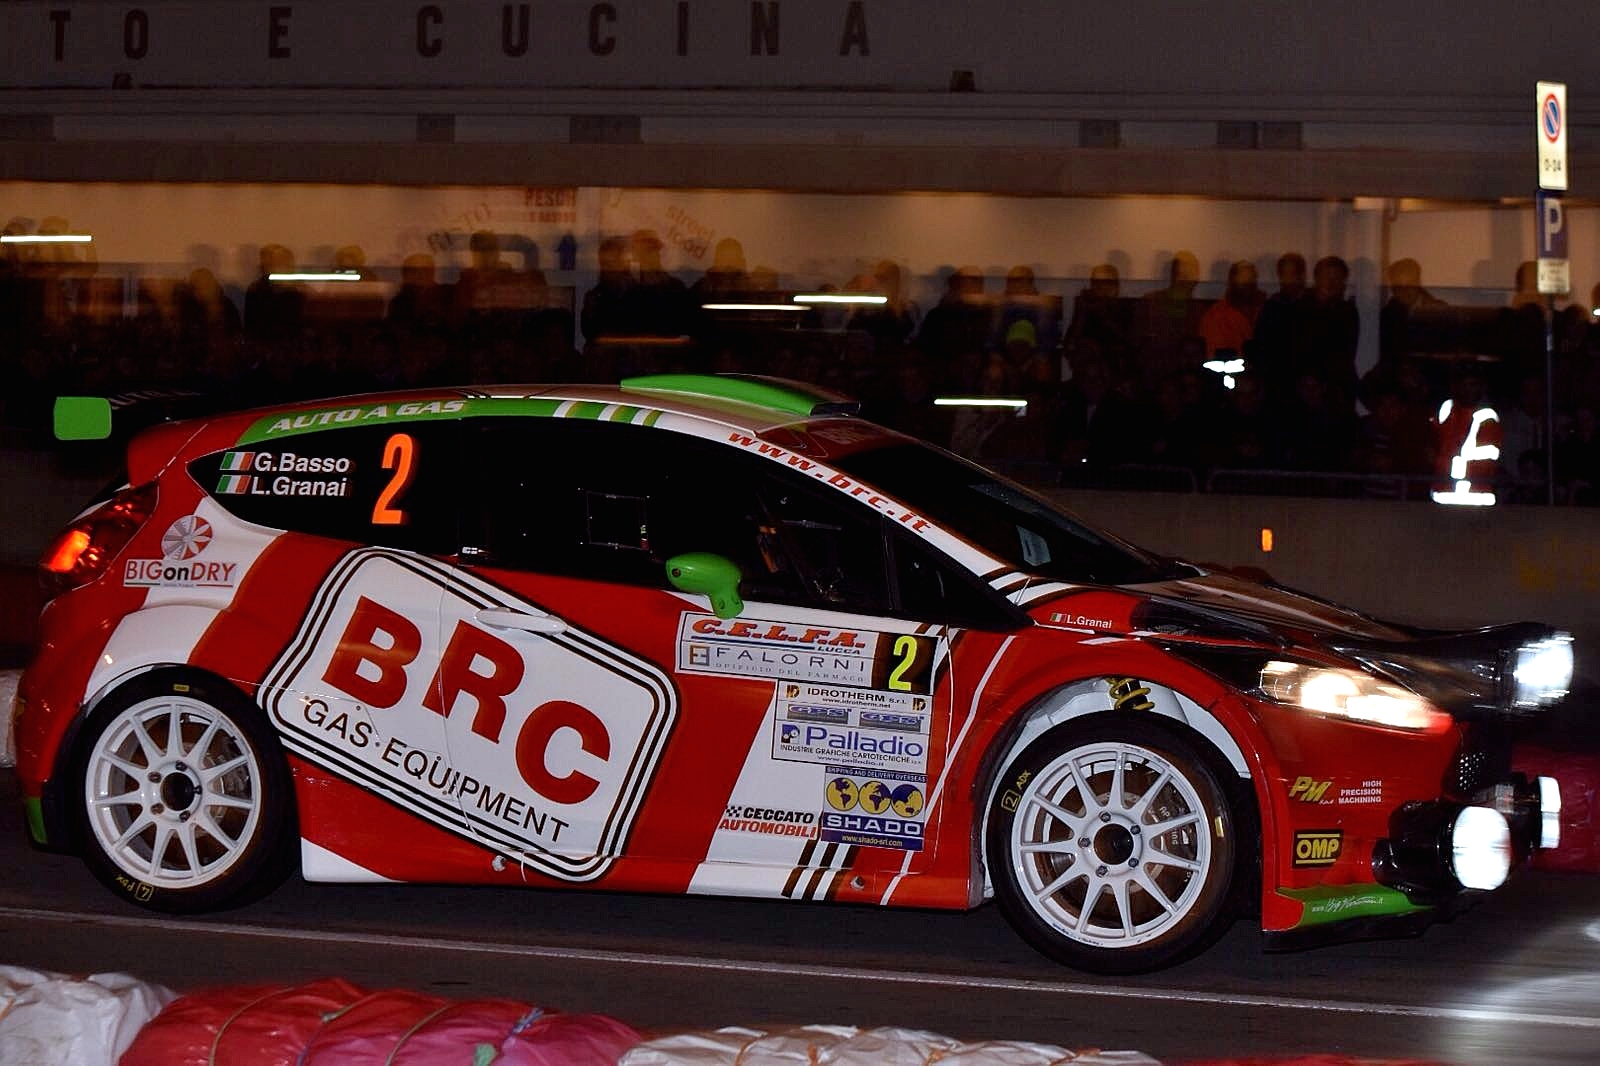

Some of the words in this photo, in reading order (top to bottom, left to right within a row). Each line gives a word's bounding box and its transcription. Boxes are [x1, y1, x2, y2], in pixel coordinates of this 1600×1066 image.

[416, 1, 870, 58] CUCINA
[1543, 197, 1563, 252] P
[265, 408, 361, 434] AUTO
[362, 405, 388, 420] A
[395, 400, 467, 416] GAS
[253, 452, 350, 473] G.Basso
[250, 476, 348, 497] L.Granai
[371, 433, 414, 525] 2
[728, 432, 931, 534] www.brc.it
[124, 560, 237, 581] BIGonDRY
[1066, 614, 1113, 629] L.Granai
[691, 618, 867, 649] C.E.L.F.A.
[716, 647, 865, 673] FALORNI
[817, 645, 861, 656] LUCCA
[888, 635, 918, 691] 2
[321, 594, 611, 805] BRC
[807, 687, 885, 703] IDROTHERM
[806, 726, 923, 758] Palladio
[303, 698, 372, 748] GAS
[381, 736, 570, 843] EQUIPMENT
[1340, 788, 1382, 797] PRECISION
[1362, 780, 1382, 788] HIGH
[1338, 796, 1382, 804] MACHINING
[743, 807, 815, 824] CECCATO
[826, 814, 921, 835] SHADO
[719, 818, 817, 838] AUTOMOBILI
[1296, 838, 1340, 859] OMP
